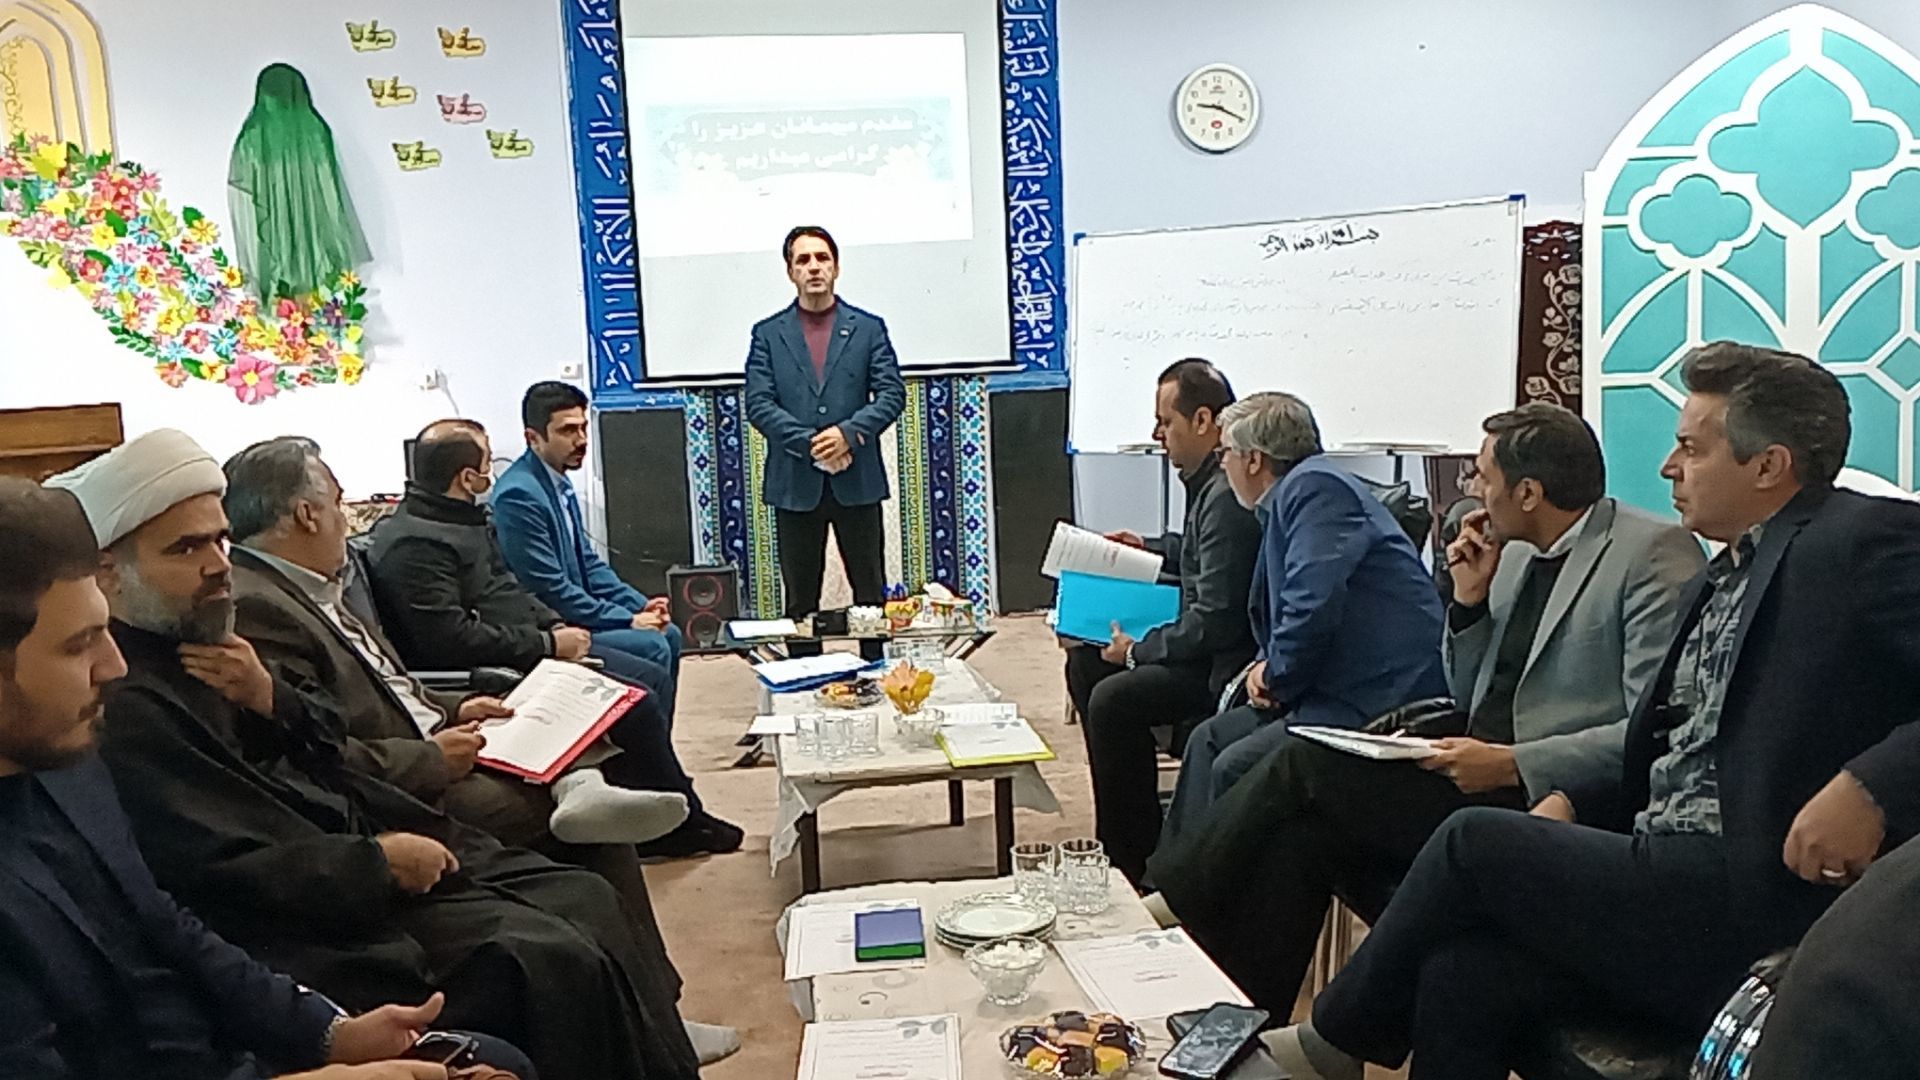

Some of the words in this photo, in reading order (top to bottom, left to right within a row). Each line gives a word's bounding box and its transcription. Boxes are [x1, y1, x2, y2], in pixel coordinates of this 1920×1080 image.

[691, 118, 708, 143] را
[715, 119, 767, 143] عزیز
[861, 114, 914, 135] مقدم
[814, 143, 880, 169] گرامی
